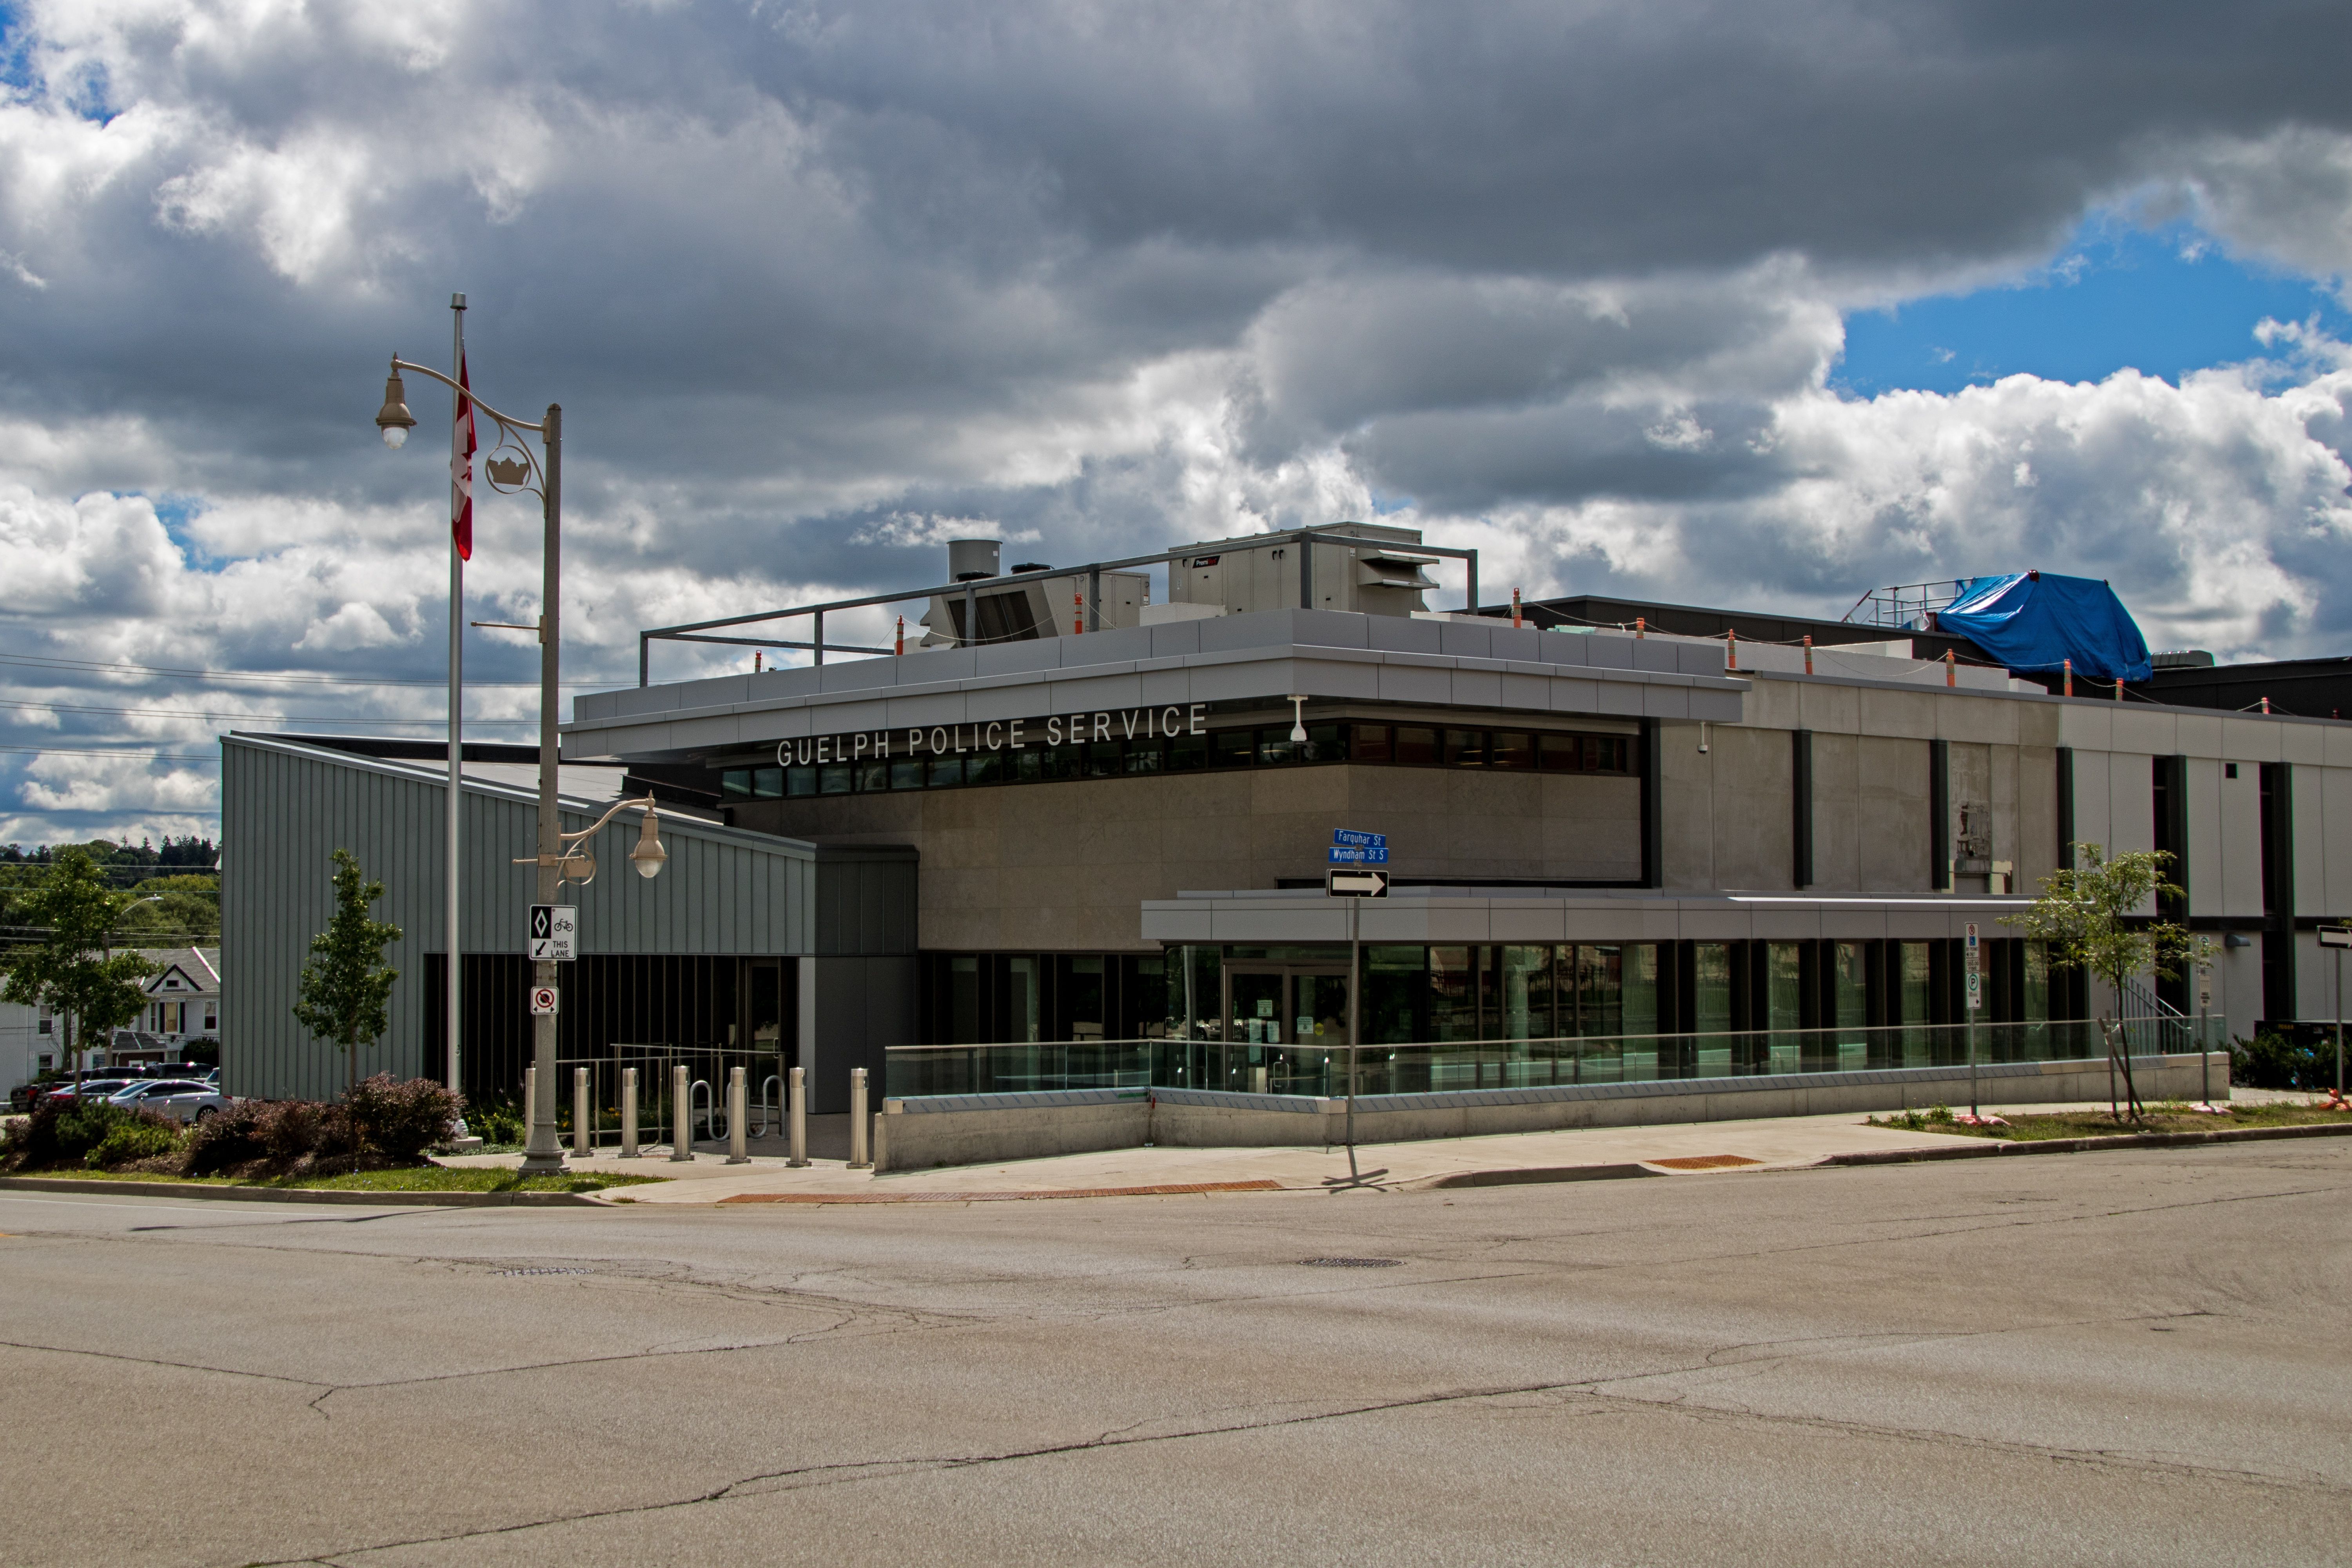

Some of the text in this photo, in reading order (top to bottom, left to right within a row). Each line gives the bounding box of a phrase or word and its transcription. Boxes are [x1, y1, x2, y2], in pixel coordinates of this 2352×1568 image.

[777, 704, 1207, 767] GUELPH POLICE SERVICE
[1339, 830, 1381, 846] Farquhar St
[1334, 849, 1384, 862] Wyndham St S
[1971, 978, 1976, 987] P
